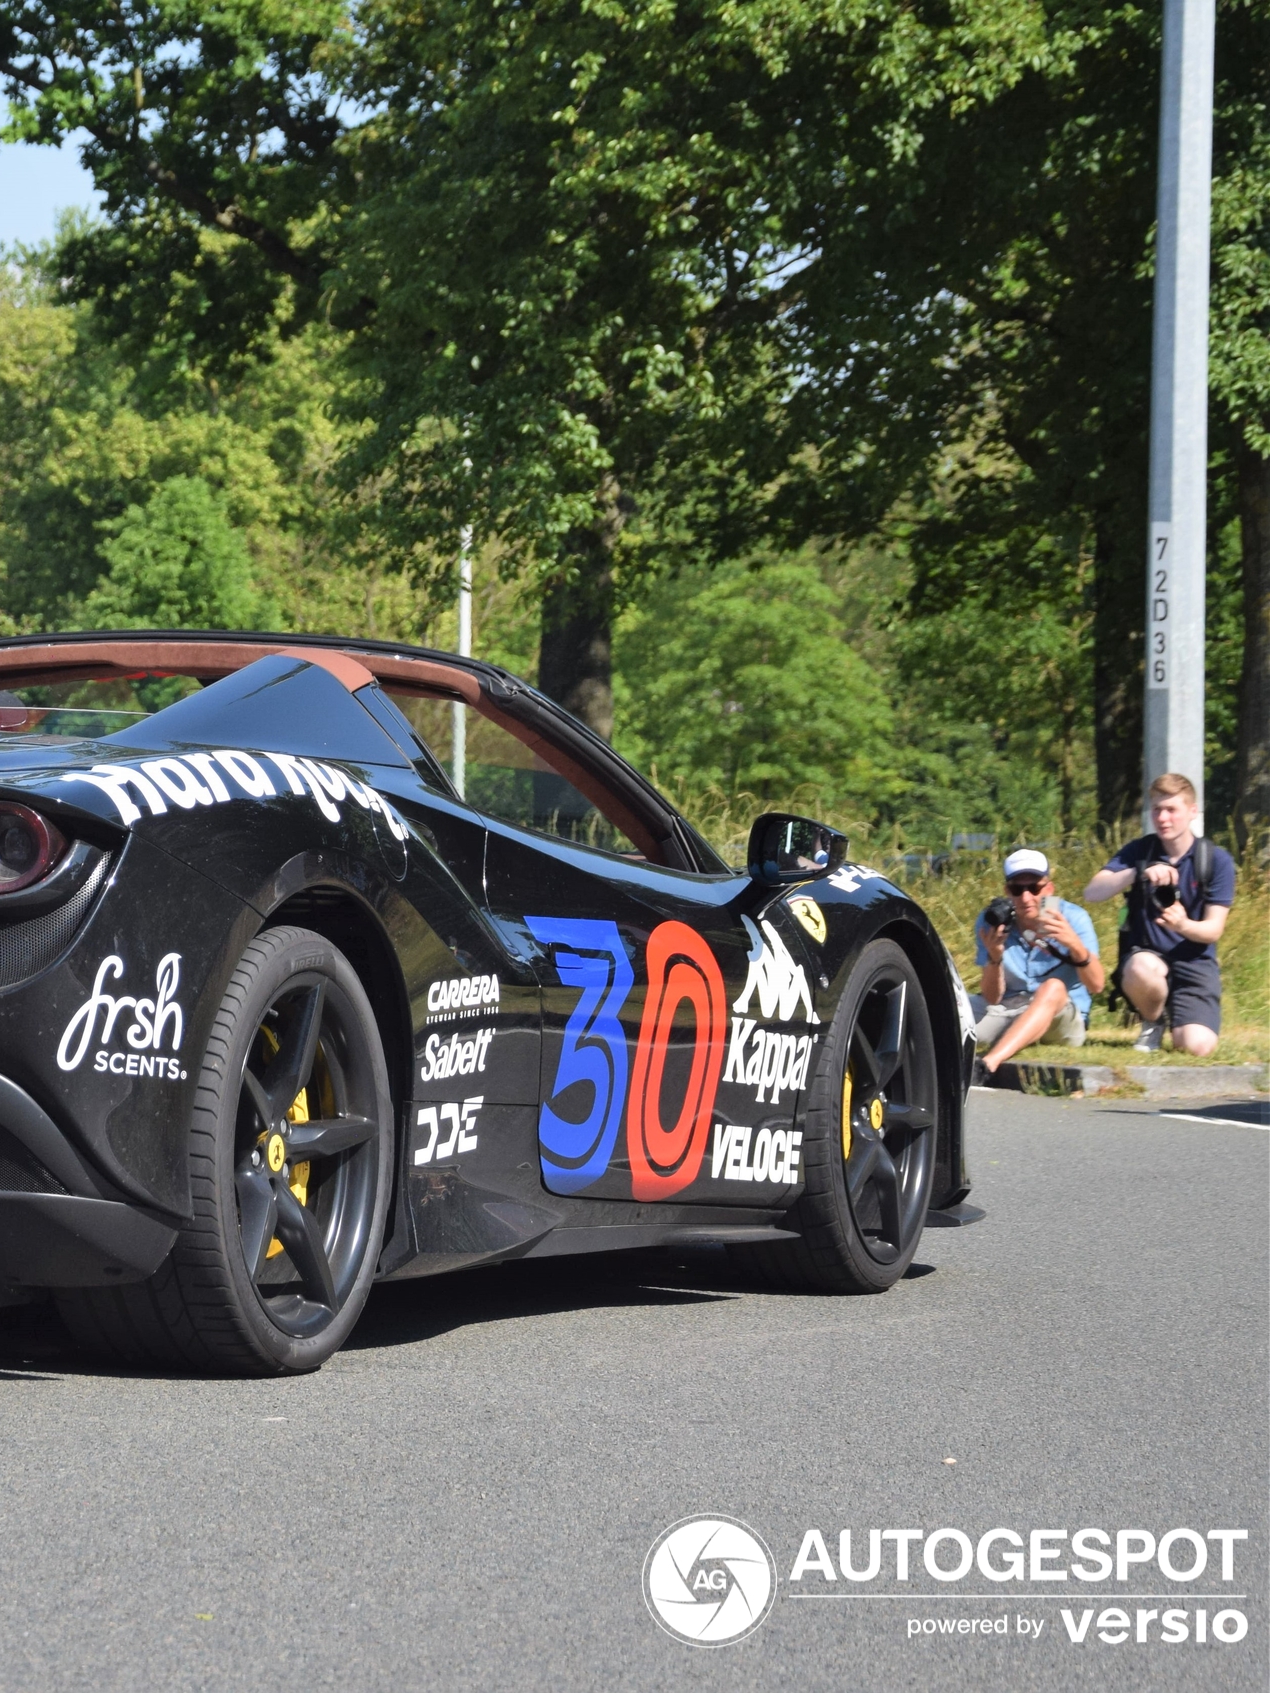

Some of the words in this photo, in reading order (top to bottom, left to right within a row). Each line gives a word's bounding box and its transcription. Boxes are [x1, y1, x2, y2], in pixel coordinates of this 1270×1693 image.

[56, 952, 183, 1072] frsh
[426, 1012, 456, 1025] EYEWEAR
[459, 1008, 480, 1019] SINCE
[483, 1005, 499, 1015] 1956
[427, 973, 500, 1012] CARRERA
[421, 1027, 494, 1082] Sabelt
[523, 915, 727, 1203] 30
[721, 1016, 814, 1105] Kappa
[711, 1123, 804, 1185] VELOCE
